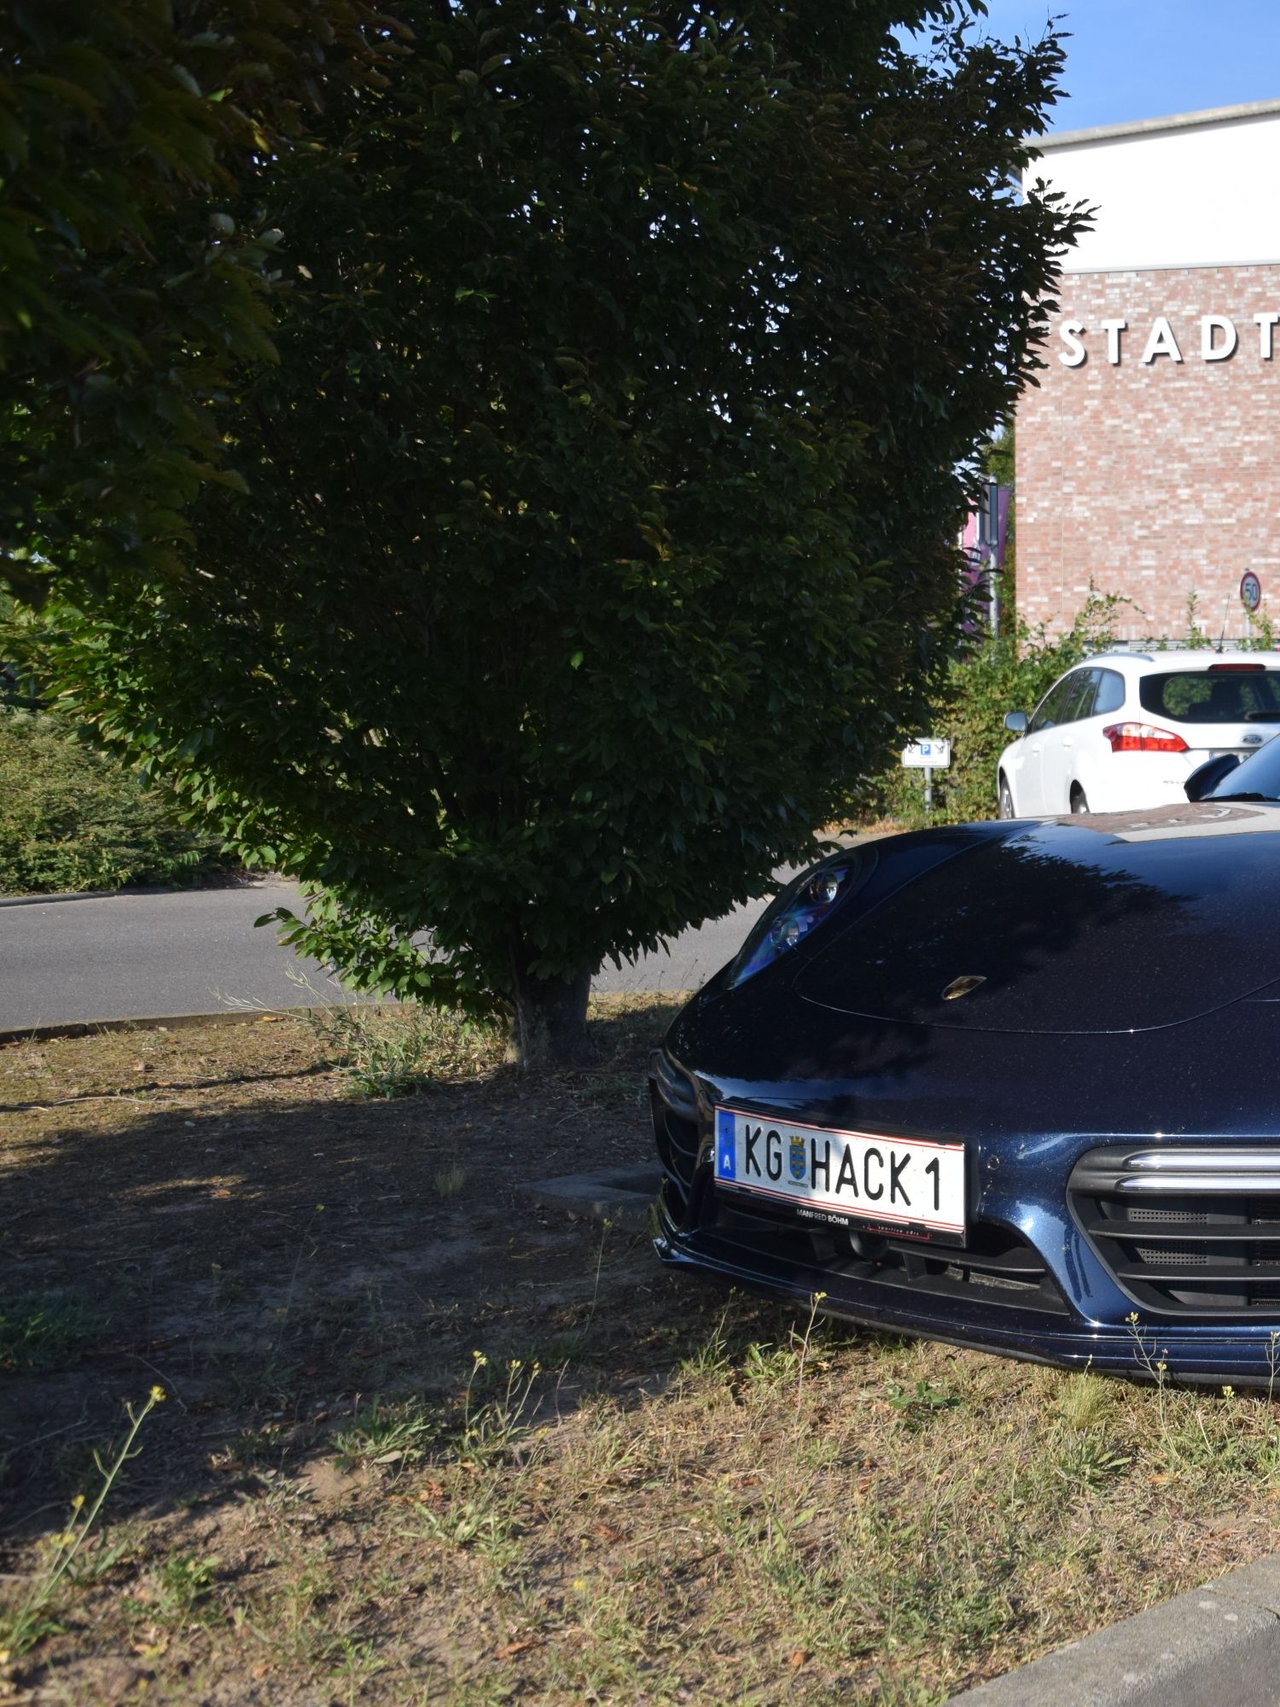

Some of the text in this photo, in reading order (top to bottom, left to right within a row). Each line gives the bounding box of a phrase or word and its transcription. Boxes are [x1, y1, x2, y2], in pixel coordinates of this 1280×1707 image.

[1245, 583, 1258, 601] 50
[723, 1155, 732, 1171] A
[744, 1124, 940, 1211] KG HACK 1
[796, 1208, 849, 1226] MANFRED BÖHM
